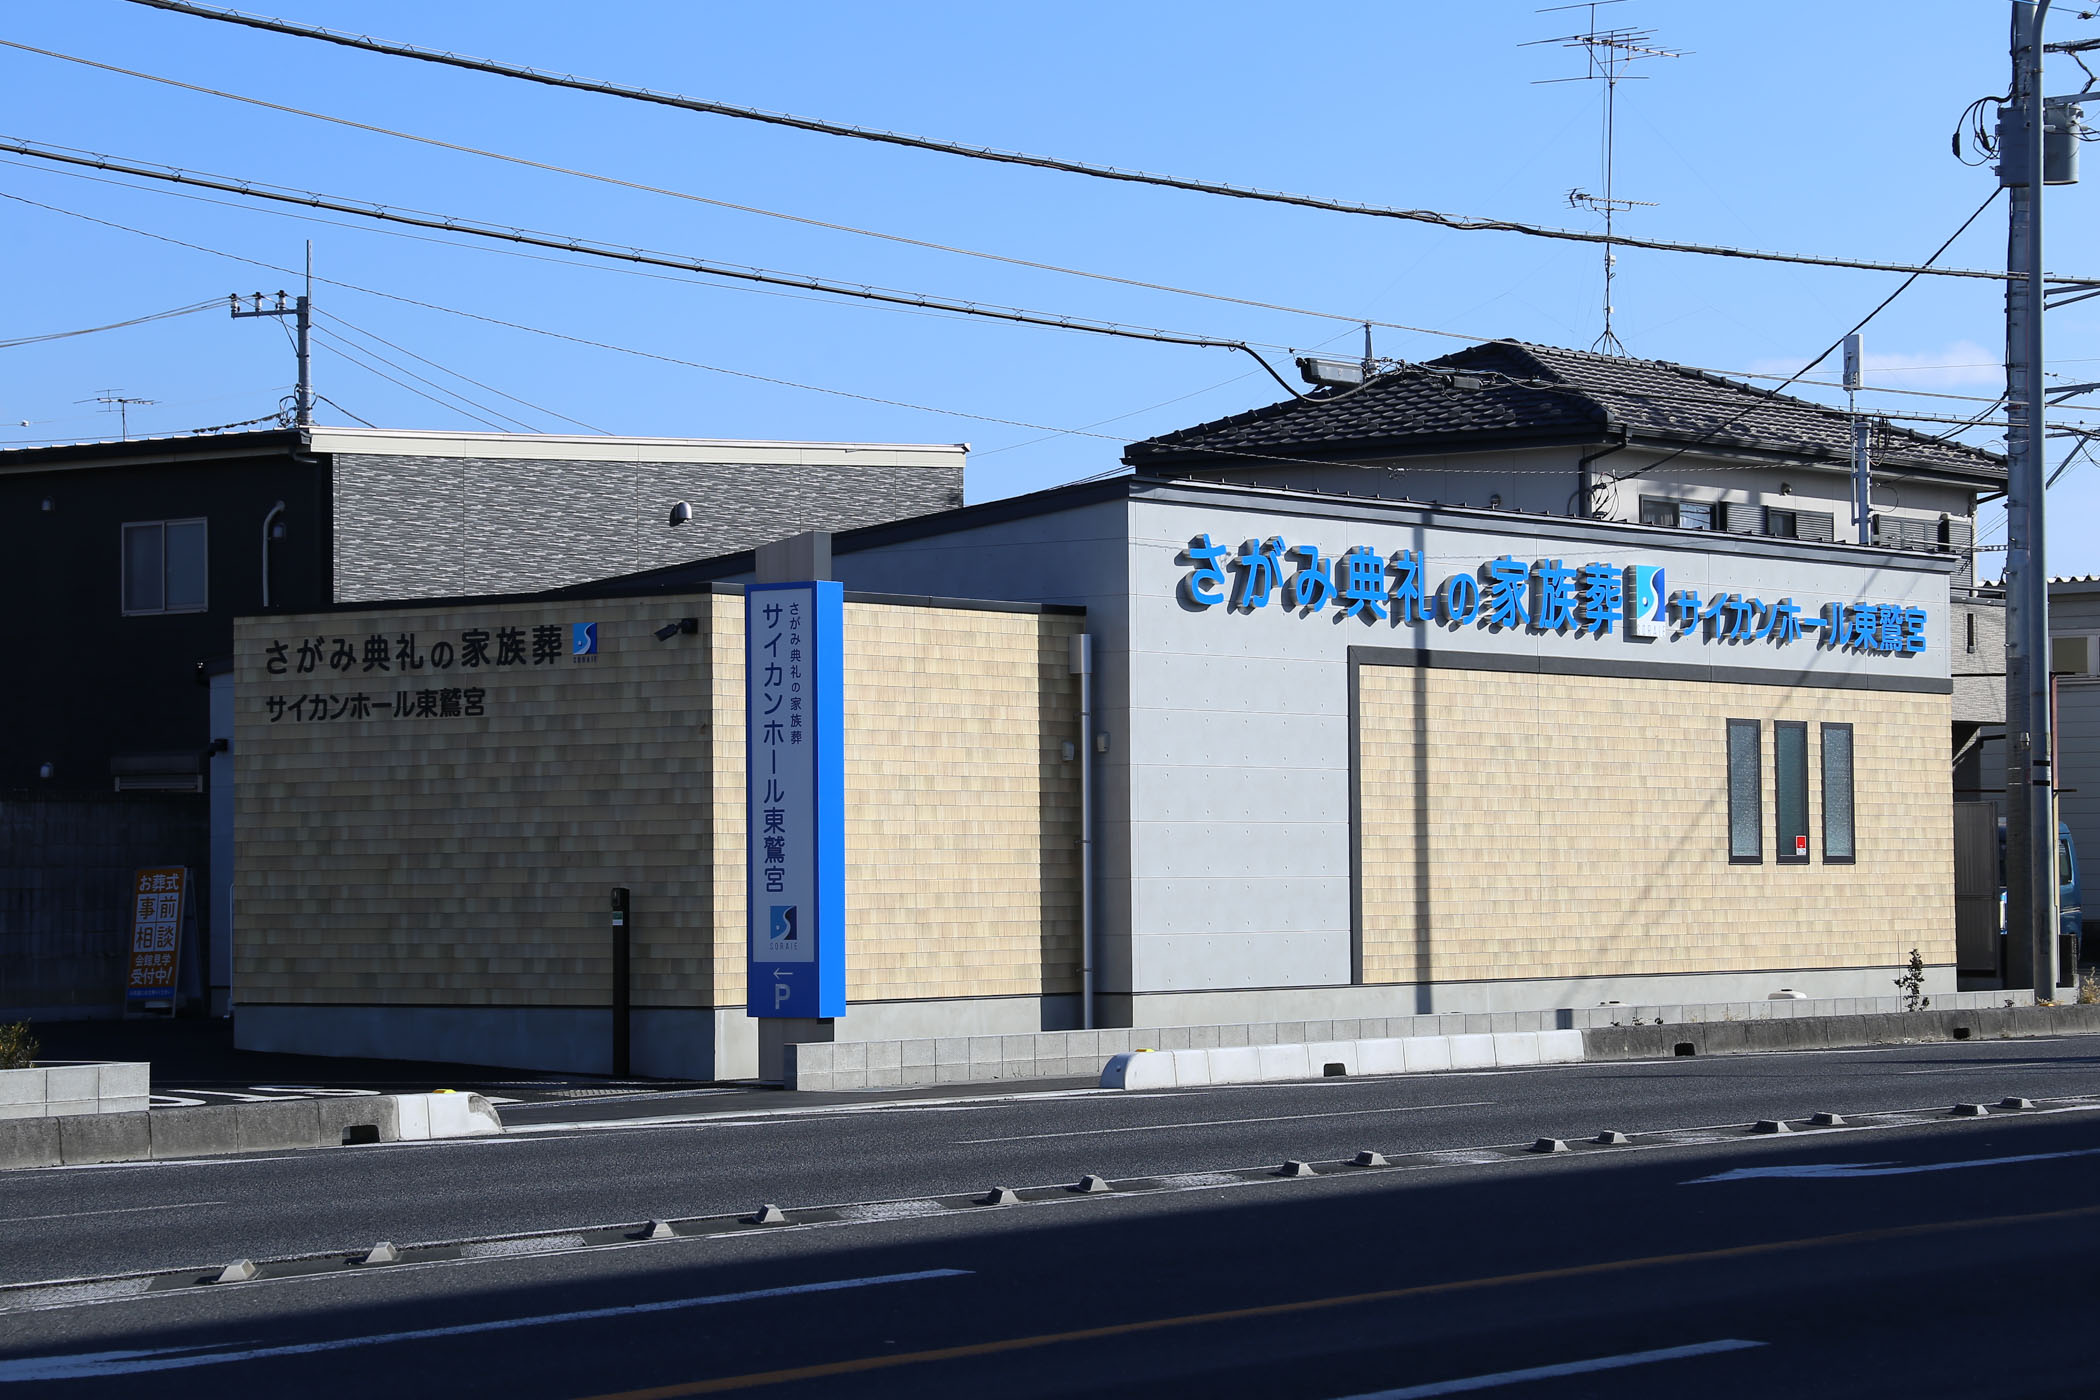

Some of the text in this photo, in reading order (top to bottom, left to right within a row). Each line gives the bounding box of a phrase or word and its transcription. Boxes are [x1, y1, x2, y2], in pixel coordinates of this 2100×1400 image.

[1188, 533, 1623, 634] さがみ典礼の家族葬
[1677, 589, 1927, 652] サイカンホール東鷲宮
[265, 624, 563, 675] さがみ典礼の家族葬
[789, 602, 802, 745] さがみ典礼の家族葬
[265, 686, 486, 723] サイカンホール東鷲宮
[762, 603, 785, 893] サイカンホール東鷲宮
[139, 873, 180, 892] お葬式
[138, 895, 177, 920] 事前
[136, 926, 174, 949] 相談
[769, 942, 798, 950] SORAIE
[135, 953, 172, 967] 会館見学
[130, 966, 173, 985] 受付中!
[775, 983, 791, 1010] P
